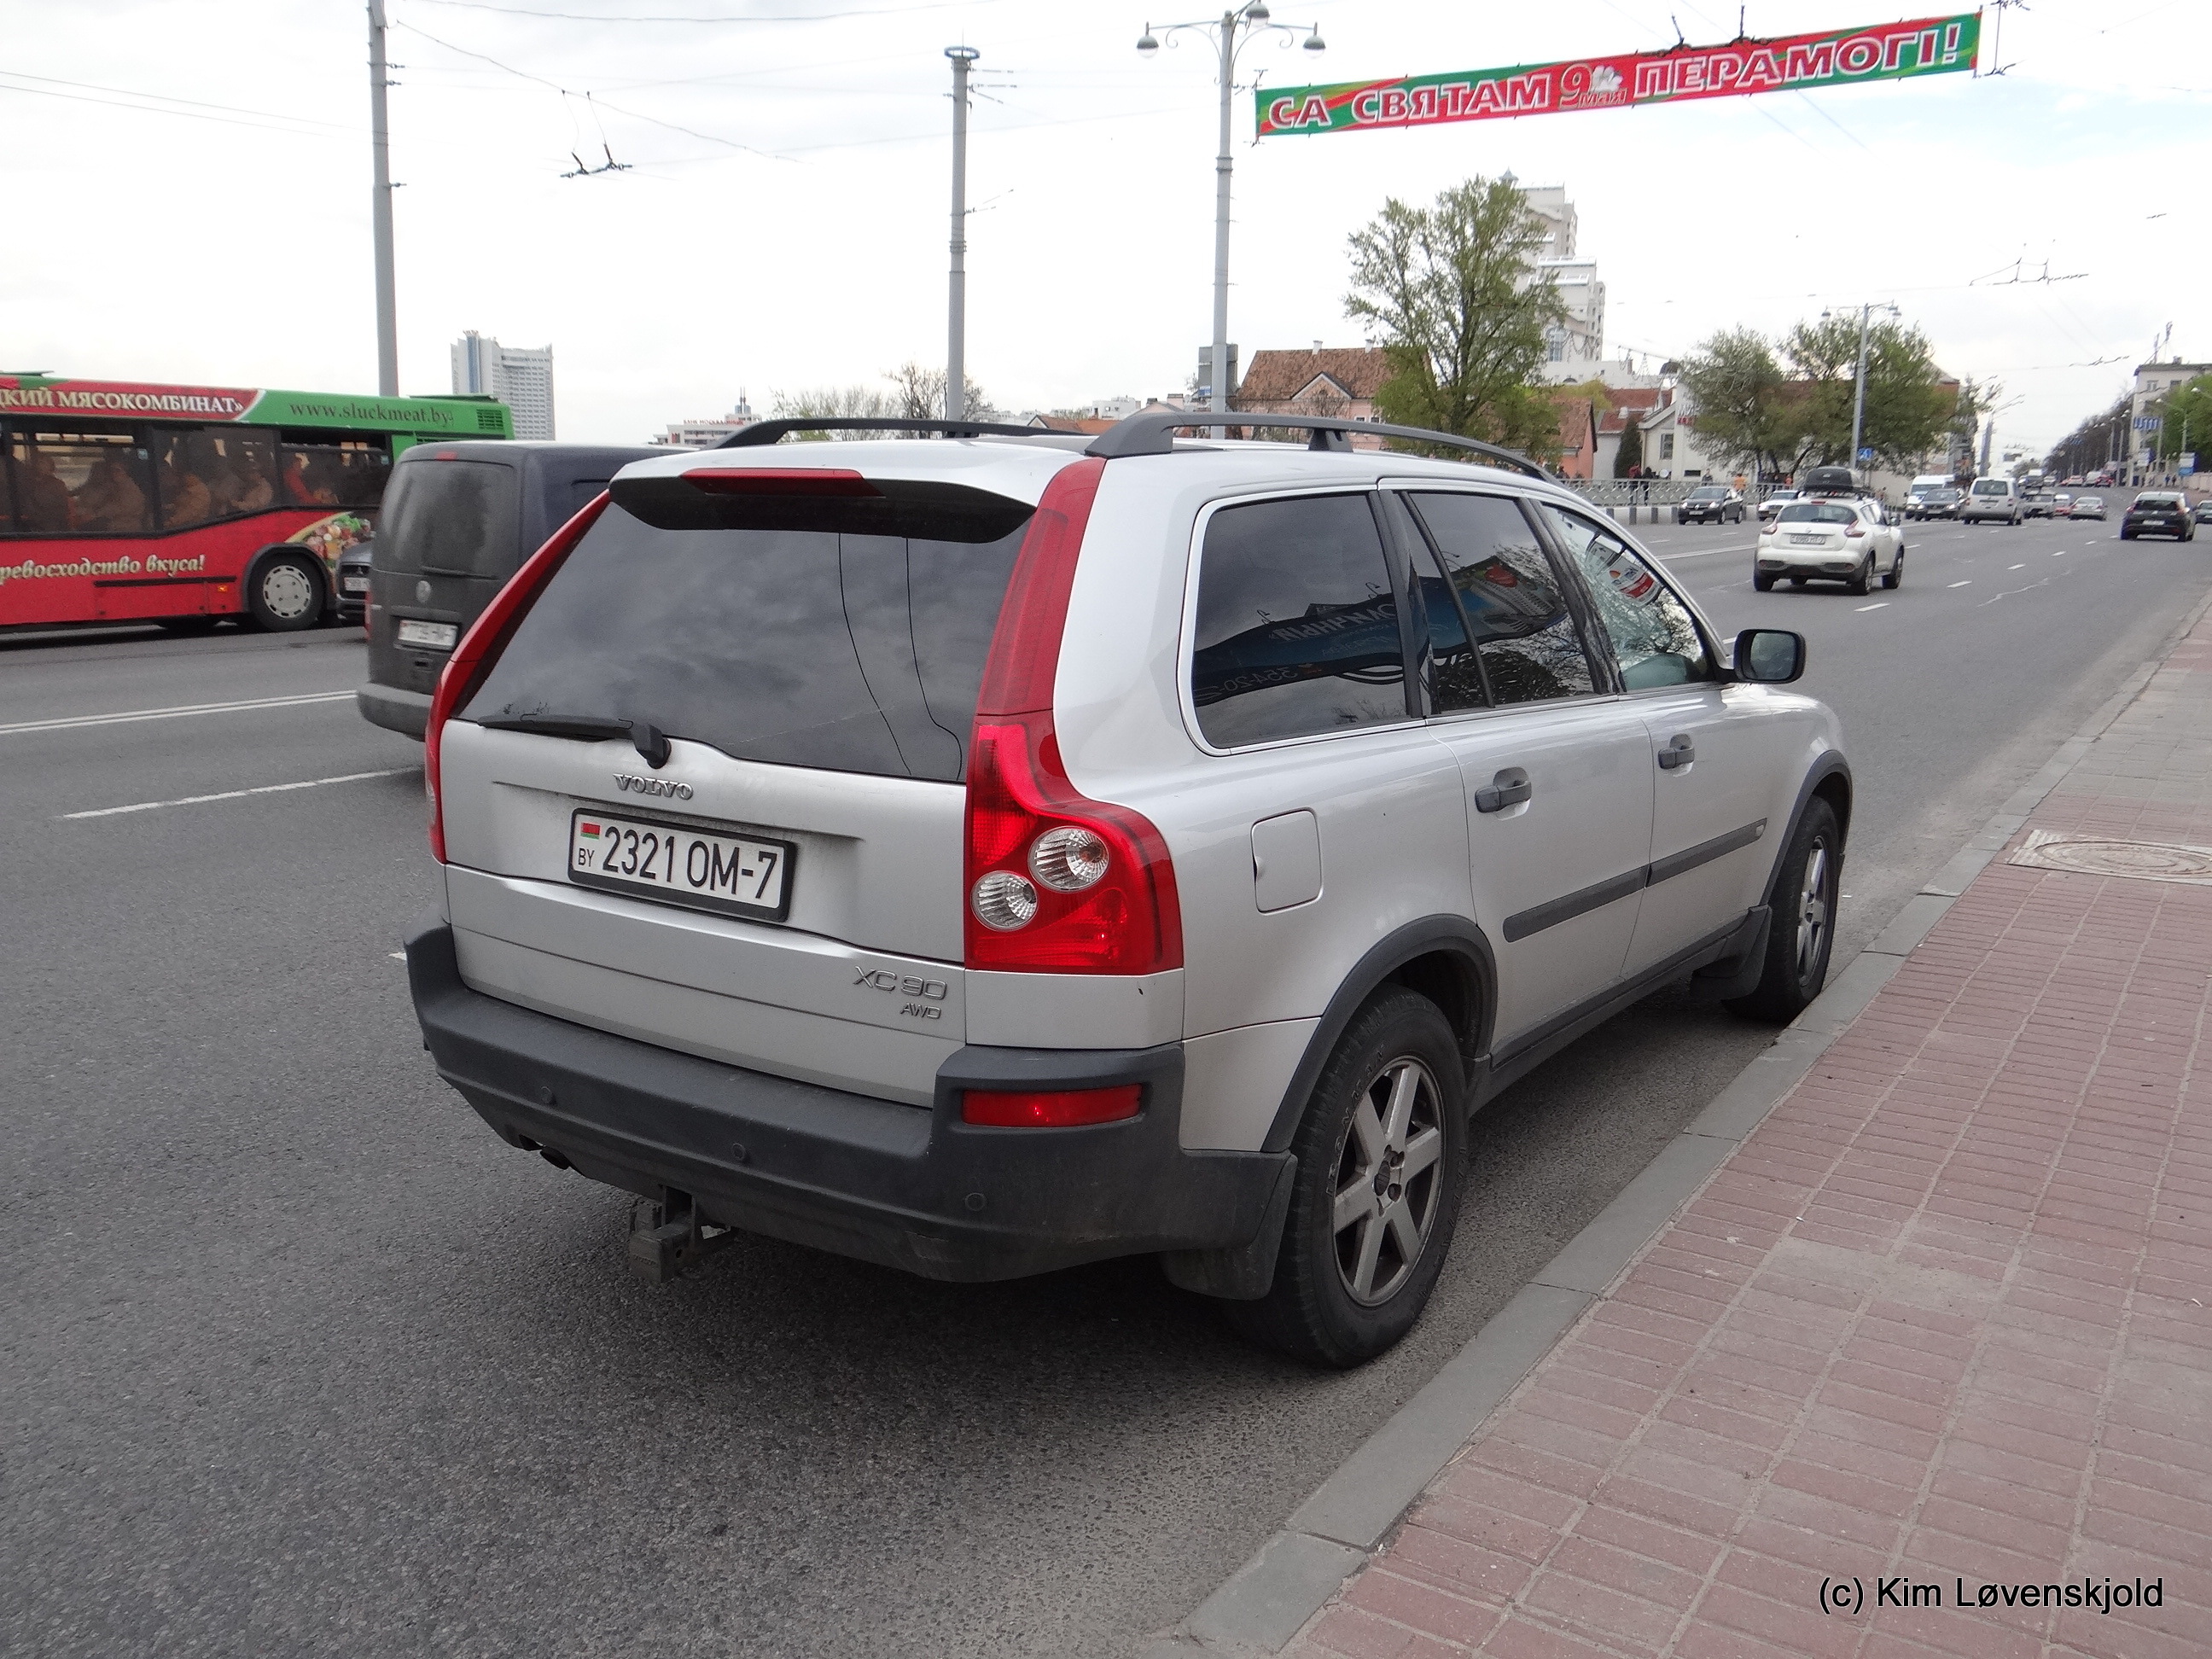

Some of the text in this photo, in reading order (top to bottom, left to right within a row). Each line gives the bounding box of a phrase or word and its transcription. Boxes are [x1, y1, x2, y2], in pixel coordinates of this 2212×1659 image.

[1268, 94, 1332, 129] СА
[1351, 73, 1551, 125] СВЯТАМ
[1559, 62, 1593, 110] 9
[1633, 23, 1962, 98] ПЕРАМОГІ!
[56, 390, 244, 413] МЯСОКОМБИНАТ»
[145, 554, 207, 578] вкуса!
[613, 773, 694, 800] VOLVO
[578, 847, 595, 867] BY
[602, 825, 778, 899] 2321 OM-7
[900, 1003, 941, 1020] AWD
